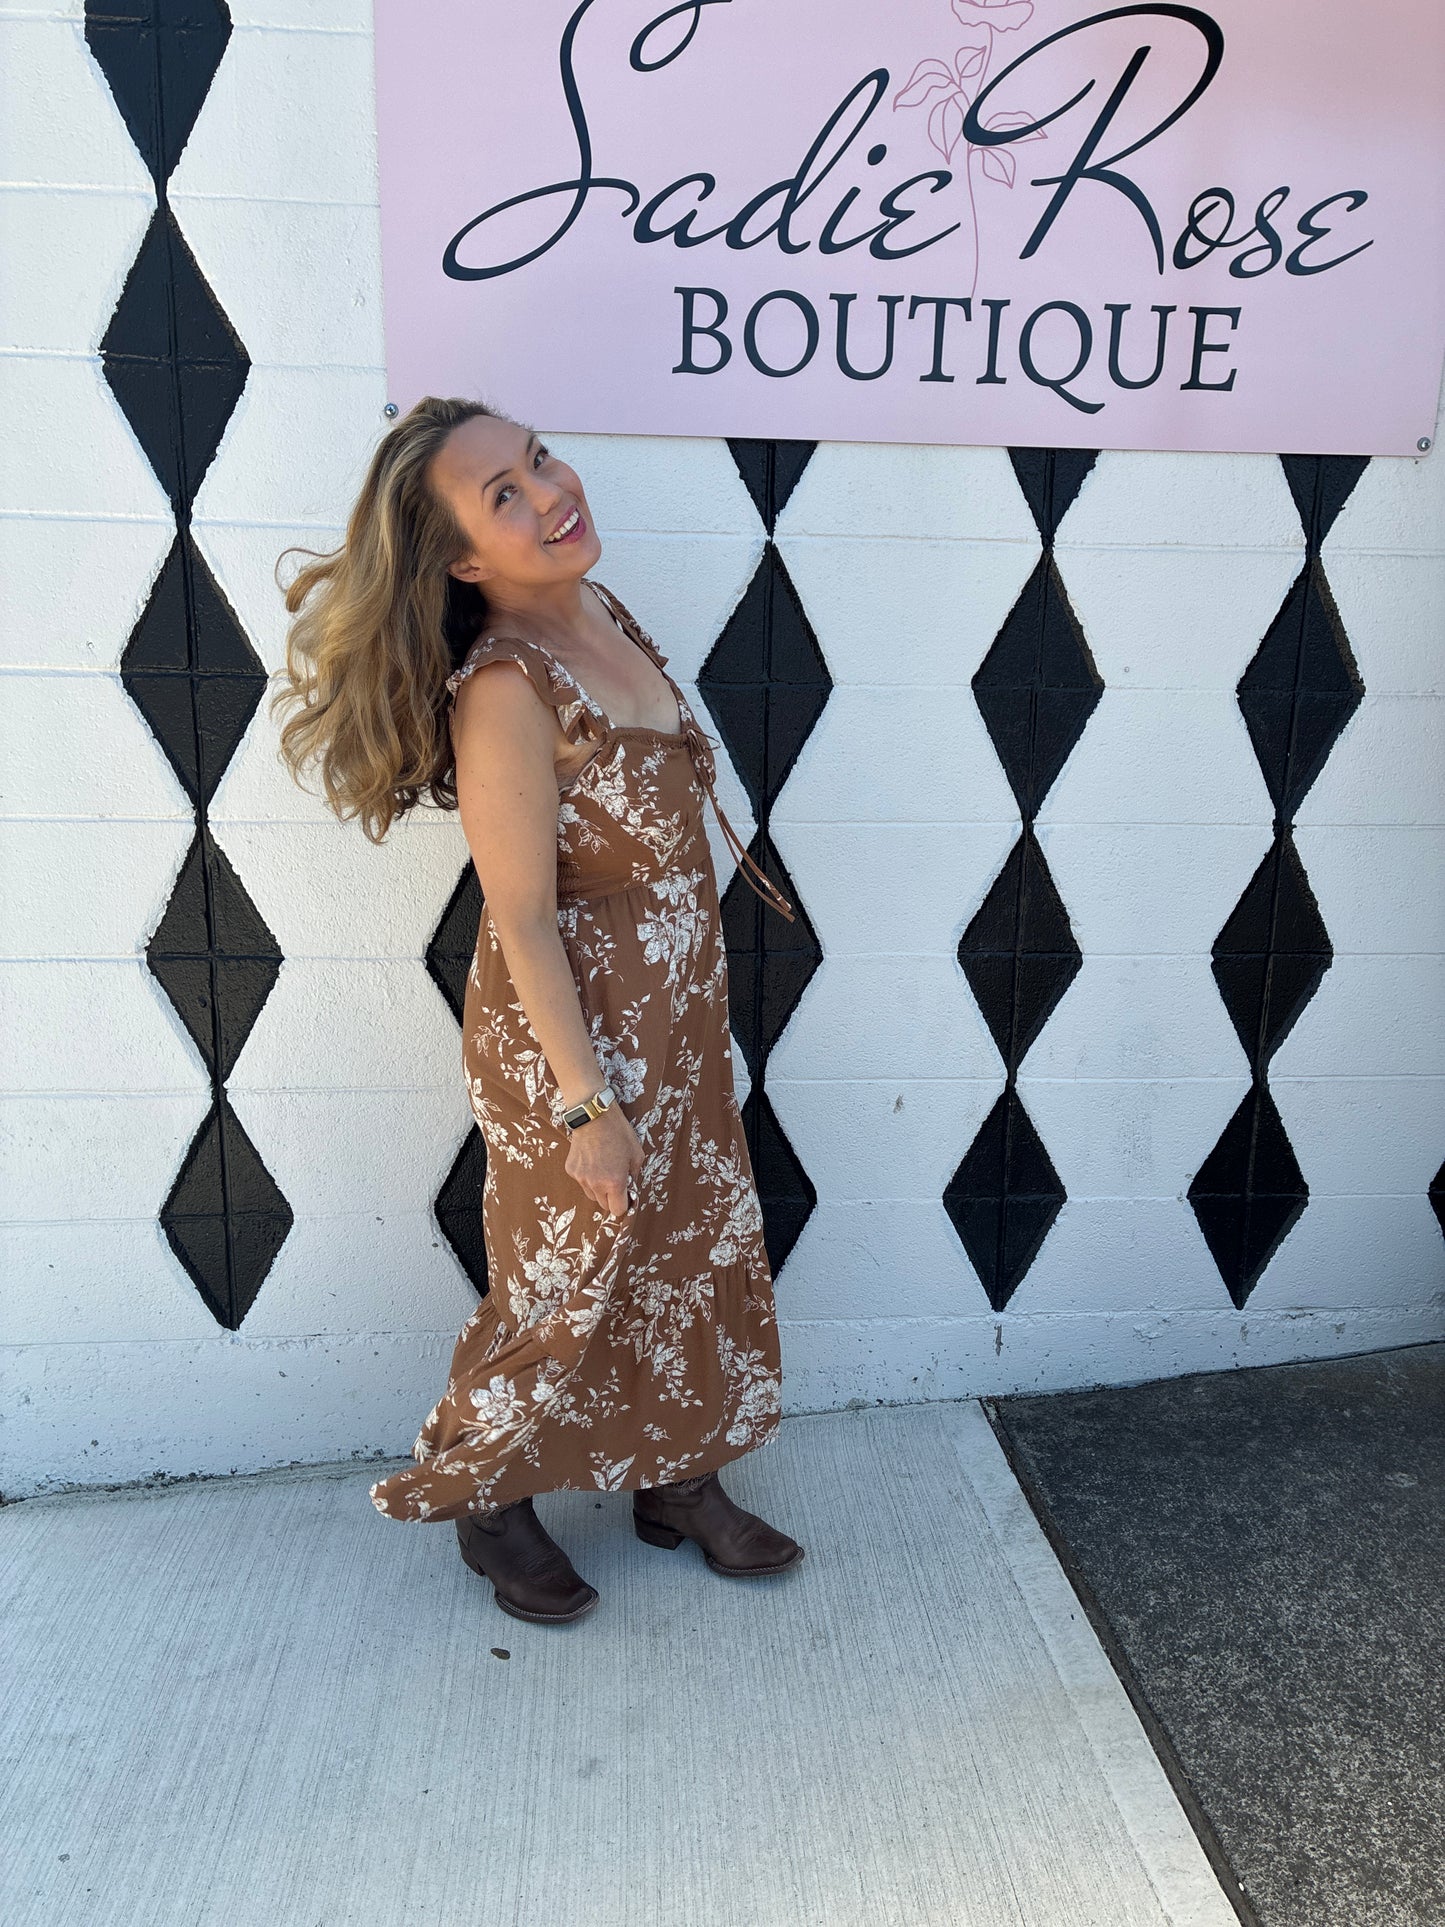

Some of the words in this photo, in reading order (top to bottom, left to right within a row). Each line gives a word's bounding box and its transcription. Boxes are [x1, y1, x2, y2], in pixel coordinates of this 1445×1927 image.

[443, 0, 960, 281] Sadie
[962, 3, 1374, 278] Rose
[672, 286, 1242, 415] BOUTIQUE
